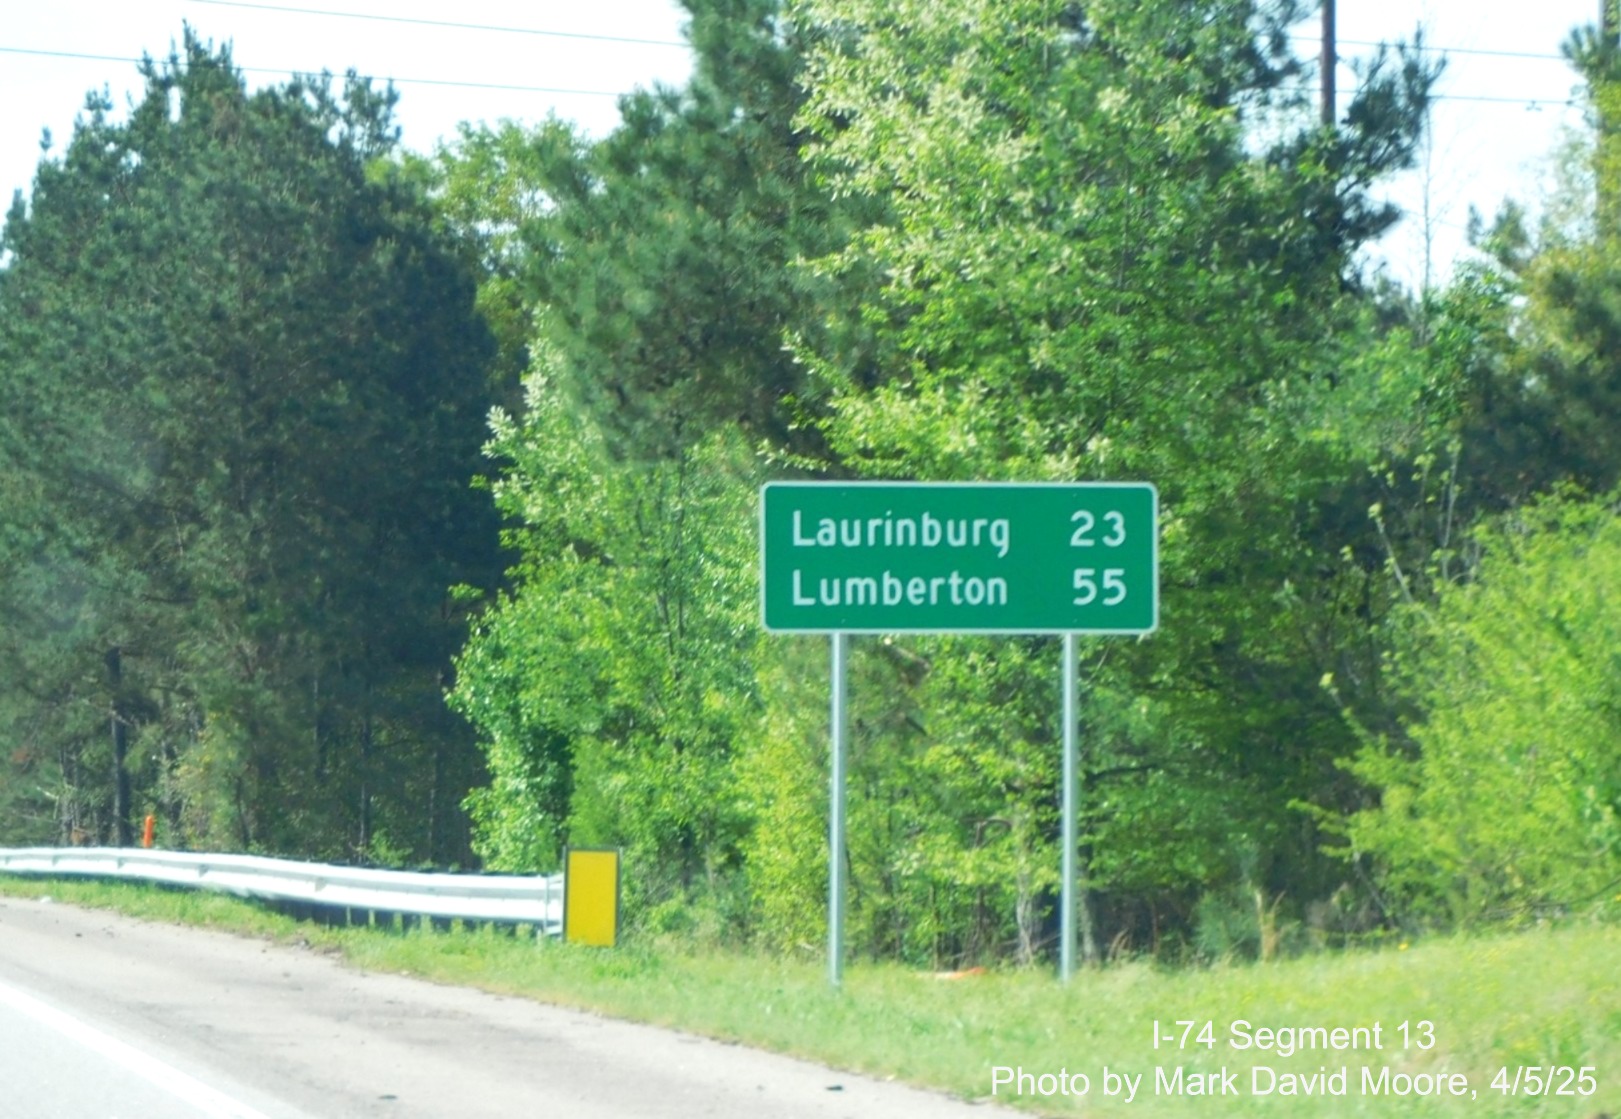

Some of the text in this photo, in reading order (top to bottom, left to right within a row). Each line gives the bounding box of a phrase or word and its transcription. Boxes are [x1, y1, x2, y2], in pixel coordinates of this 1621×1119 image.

[792, 509, 1126, 558] Laurinburg 23
[792, 568, 1127, 607] Lumberton 55
